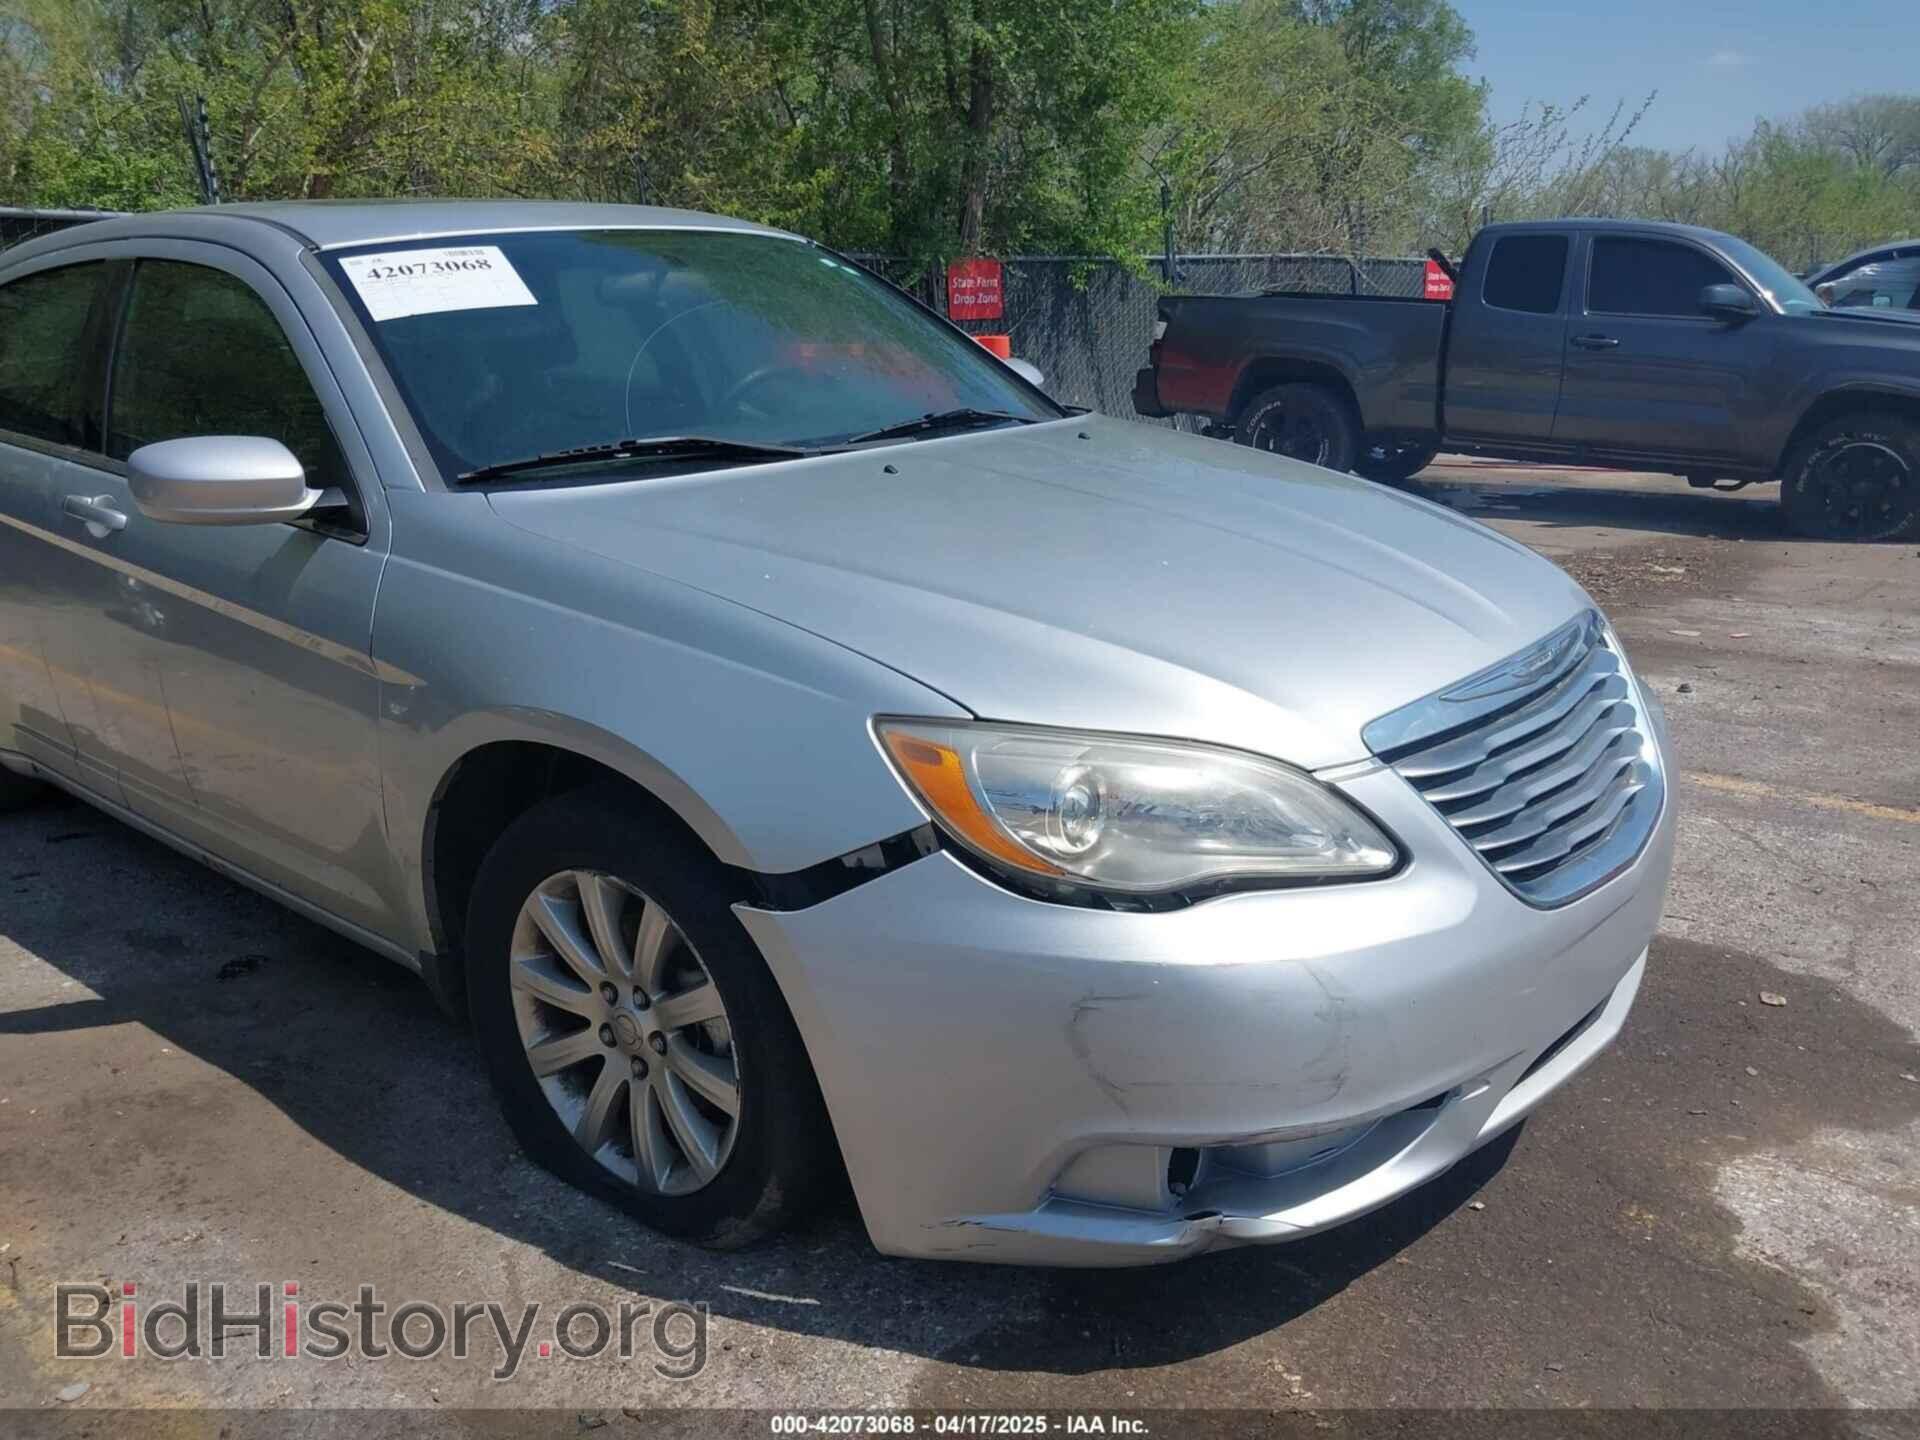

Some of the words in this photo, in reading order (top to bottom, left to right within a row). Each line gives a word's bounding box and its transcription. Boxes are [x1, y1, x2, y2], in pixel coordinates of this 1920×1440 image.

[367, 258, 492, 280] 42073068
[952, 276, 975, 288] State
[954, 293, 976, 305] Drop
[976, 292, 998, 303] Zone
